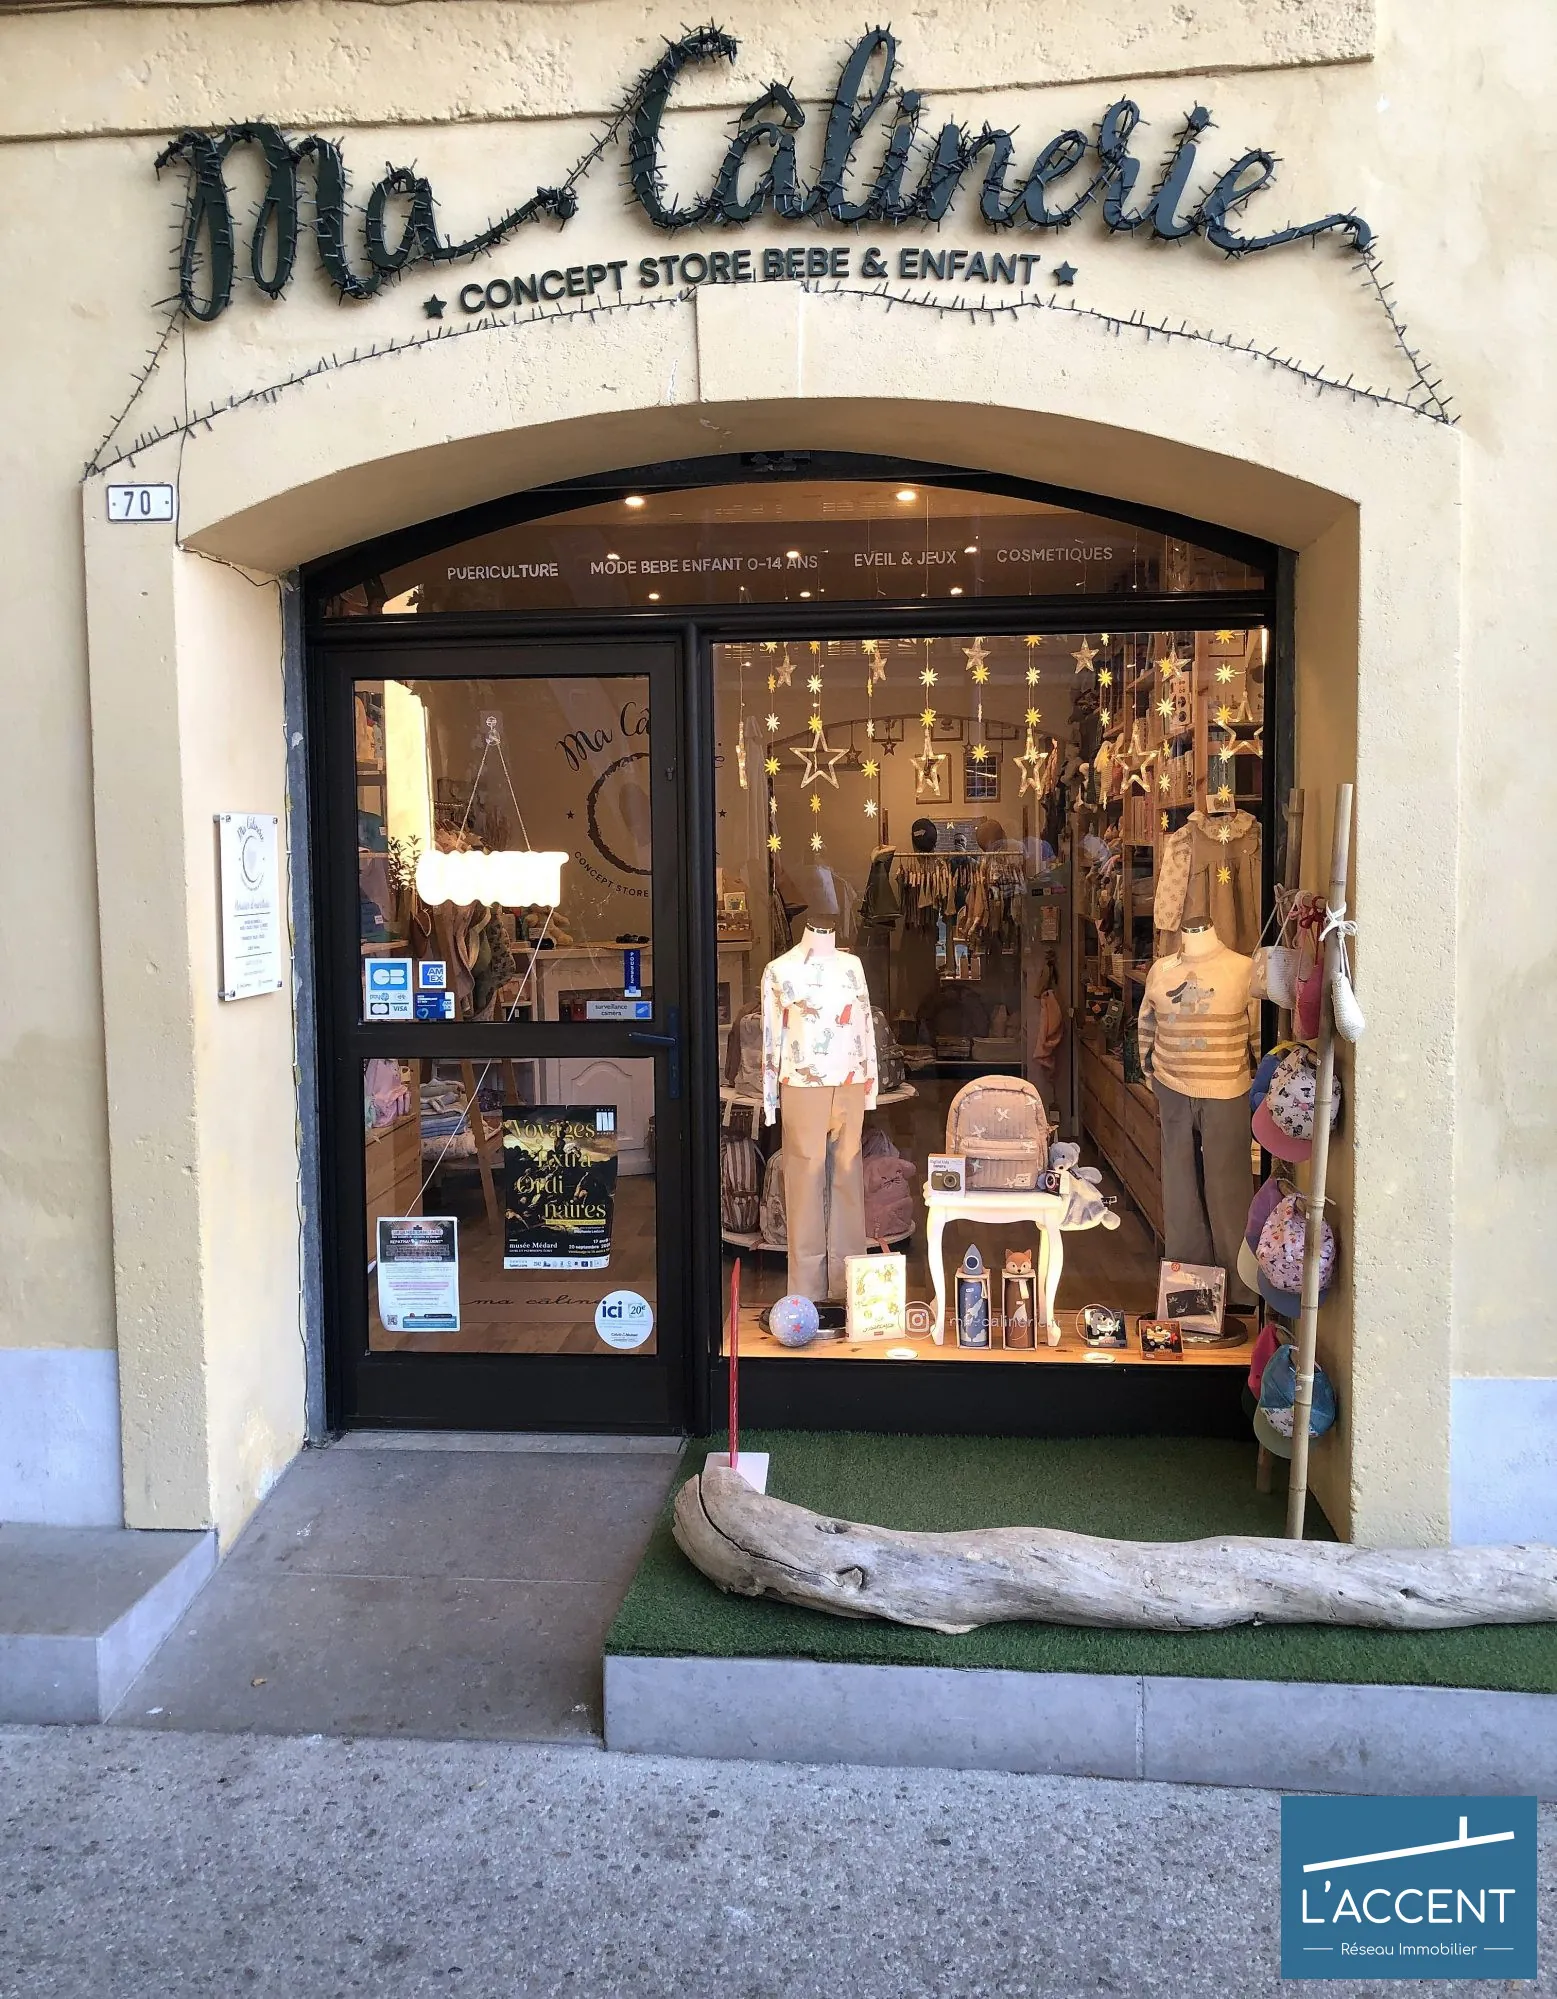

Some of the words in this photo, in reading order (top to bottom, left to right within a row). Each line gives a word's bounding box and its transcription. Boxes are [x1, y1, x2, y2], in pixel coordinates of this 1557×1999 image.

[155, 118, 579, 322] Ma
[460, 260, 628, 313] CONCEPT
[639, 248, 753, 287] STORE
[763, 247, 851, 281] BEBE
[861, 248, 889, 279] &
[899, 248, 1042, 286] ENFANT
[123, 490, 151, 517] 70
[854, 552, 896, 568] EVEIL
[901, 552, 914, 567] &
[917, 550, 957, 566] JEUX
[996, 546, 1113, 564] COSMETIQUES
[447, 562, 559, 581] PUERICULTURE
[590, 560, 637, 576] MODE
[640, 560, 680, 574] BEBE
[682, 557, 744, 573] ENFANT
[786, 555, 818, 569] ANS
[555, 728, 613, 772] Ma
[574, 851, 613, 889] CONCEPT
[615, 885, 650, 899] STORE
[515, 1119, 595, 1141] Voyages
[538, 1151, 593, 1168] Extra
[516, 1175, 564, 1194] Ordi
[544, 1199, 606, 1218] naires
[602, 1300, 623, 1318] ici
